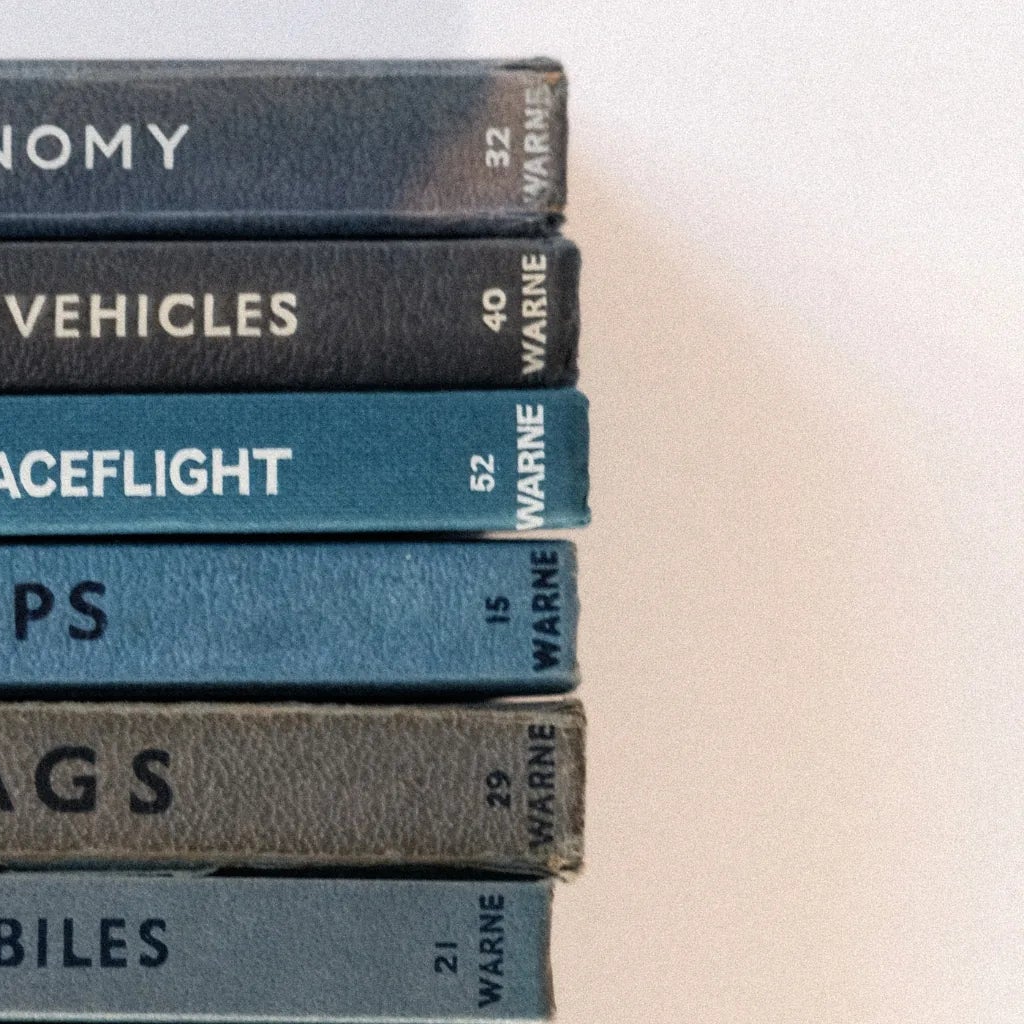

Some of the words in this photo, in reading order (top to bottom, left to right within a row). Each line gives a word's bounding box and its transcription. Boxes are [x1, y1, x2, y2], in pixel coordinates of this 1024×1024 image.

[486, 126, 511, 168] 32
[5, 289, 302, 341] VEHICLES
[482, 287, 507, 332] 40
[522, 254, 547, 375] WARNE
[470, 454, 495, 492] 52
[516, 404, 545, 531] WARNE
[485, 595, 511, 624] 15
[531, 550, 561, 672] WARNE
[487, 769, 511, 809] 29
[528, 722, 556, 848] WARNE
[435, 941, 459, 974] 21
[478, 894, 505, 1010] WARNE
